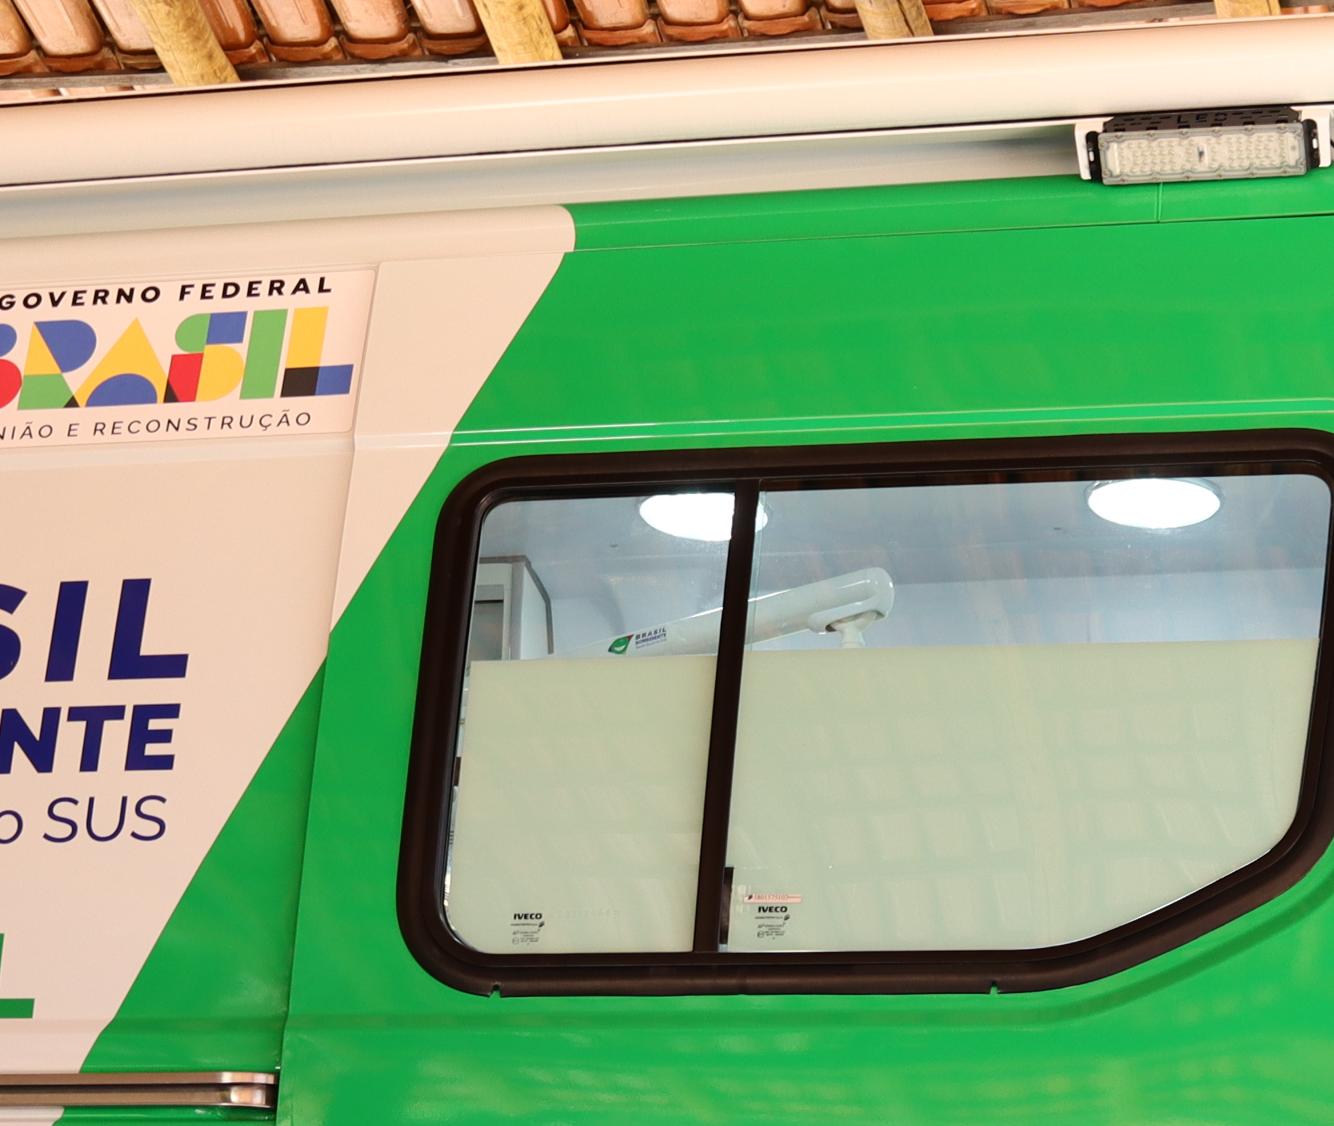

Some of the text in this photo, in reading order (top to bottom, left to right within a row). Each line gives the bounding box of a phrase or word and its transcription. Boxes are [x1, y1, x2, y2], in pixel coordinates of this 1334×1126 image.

[1177, 113, 1228, 124] LED
[178, 276, 334, 303] FEDERAL
[67, 419, 82, 437] E
[92, 409, 313, 437] RECONSTRUÇÃO
[41, 794, 167, 845] SUS
[513, 912, 543, 920] IVECO
[758, 905, 788, 913] IVECO
